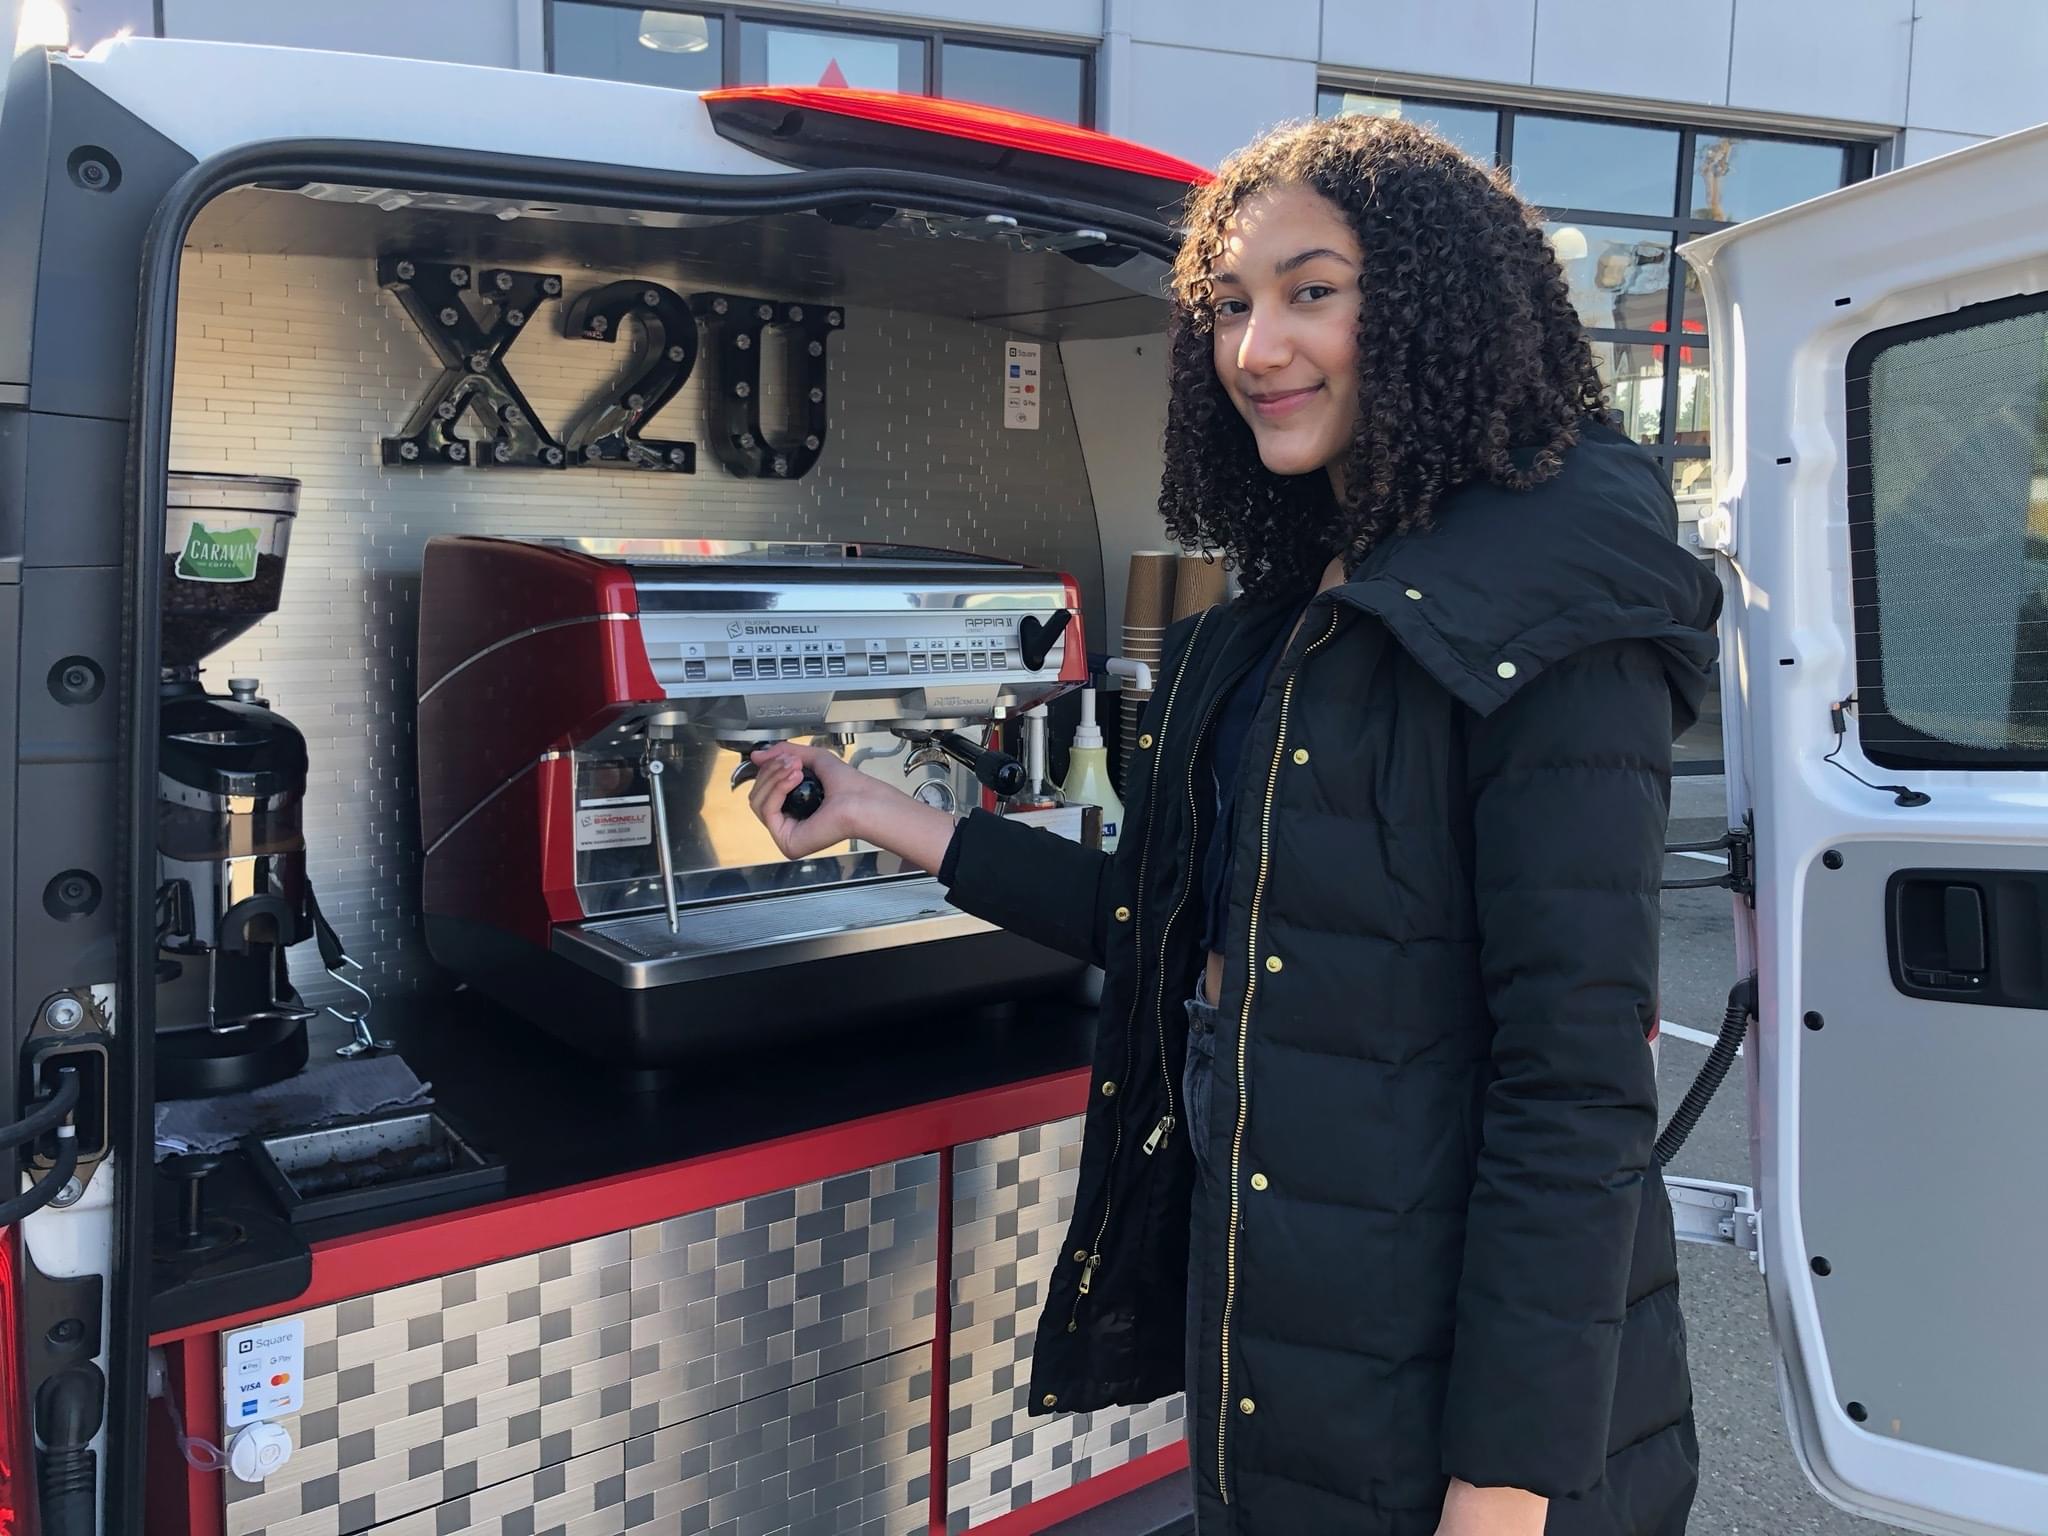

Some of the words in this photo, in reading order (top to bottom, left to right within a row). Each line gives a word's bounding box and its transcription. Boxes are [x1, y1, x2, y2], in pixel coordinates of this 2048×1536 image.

[378, 257, 845, 480] X2U
[190, 539, 255, 562] CARAVAN
[744, 625, 818, 635] SIMONELLI
[964, 618, 1004, 628] APPIA
[255, 1333, 293, 1349] Square
[240, 1381, 262, 1393] VISA
